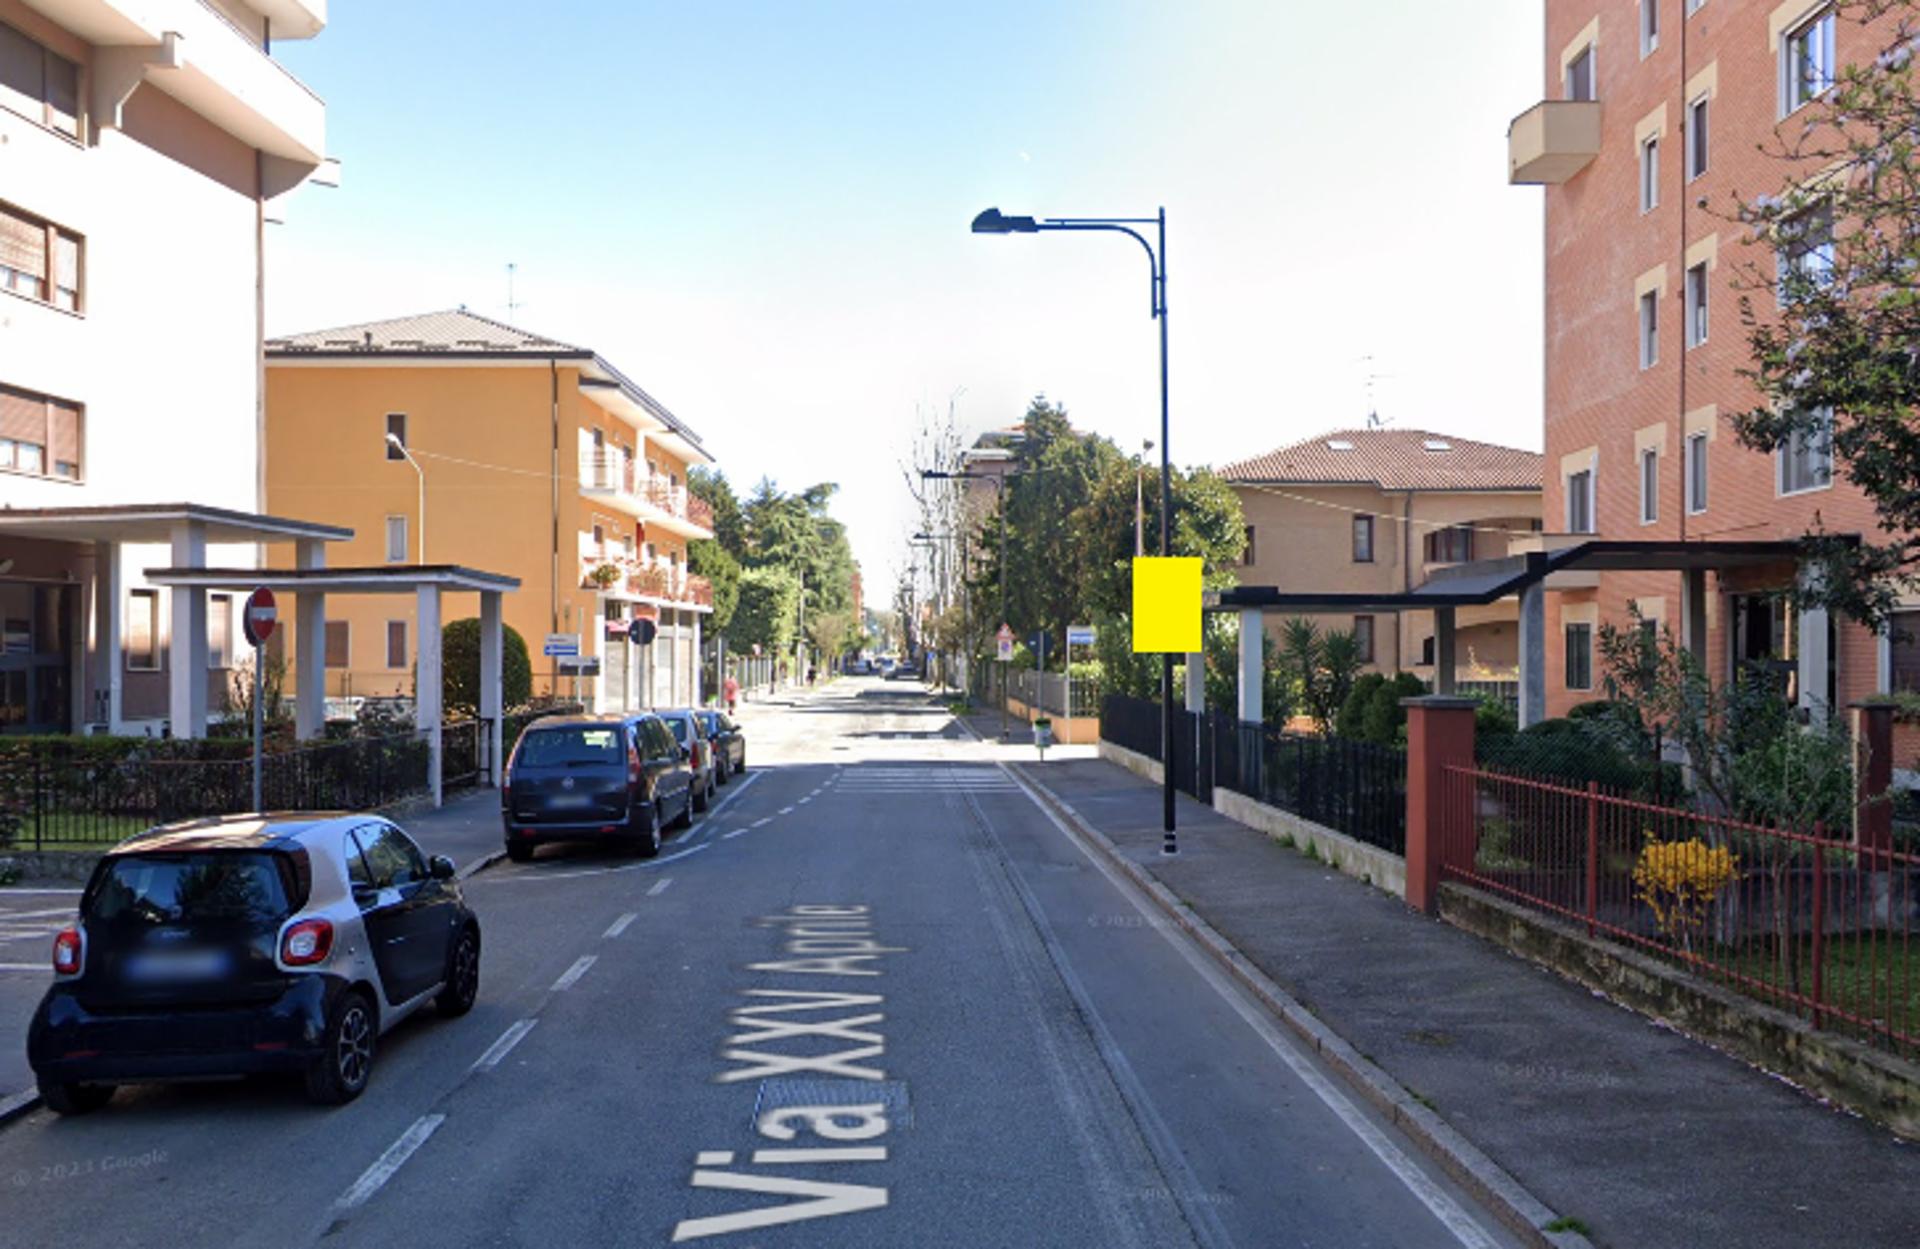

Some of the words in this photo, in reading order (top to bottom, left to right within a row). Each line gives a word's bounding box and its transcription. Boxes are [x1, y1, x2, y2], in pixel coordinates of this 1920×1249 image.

[748, 905, 909, 976] Aprile
[714, 988, 885, 1082] XXV
[672, 1103, 888, 1242] Via
